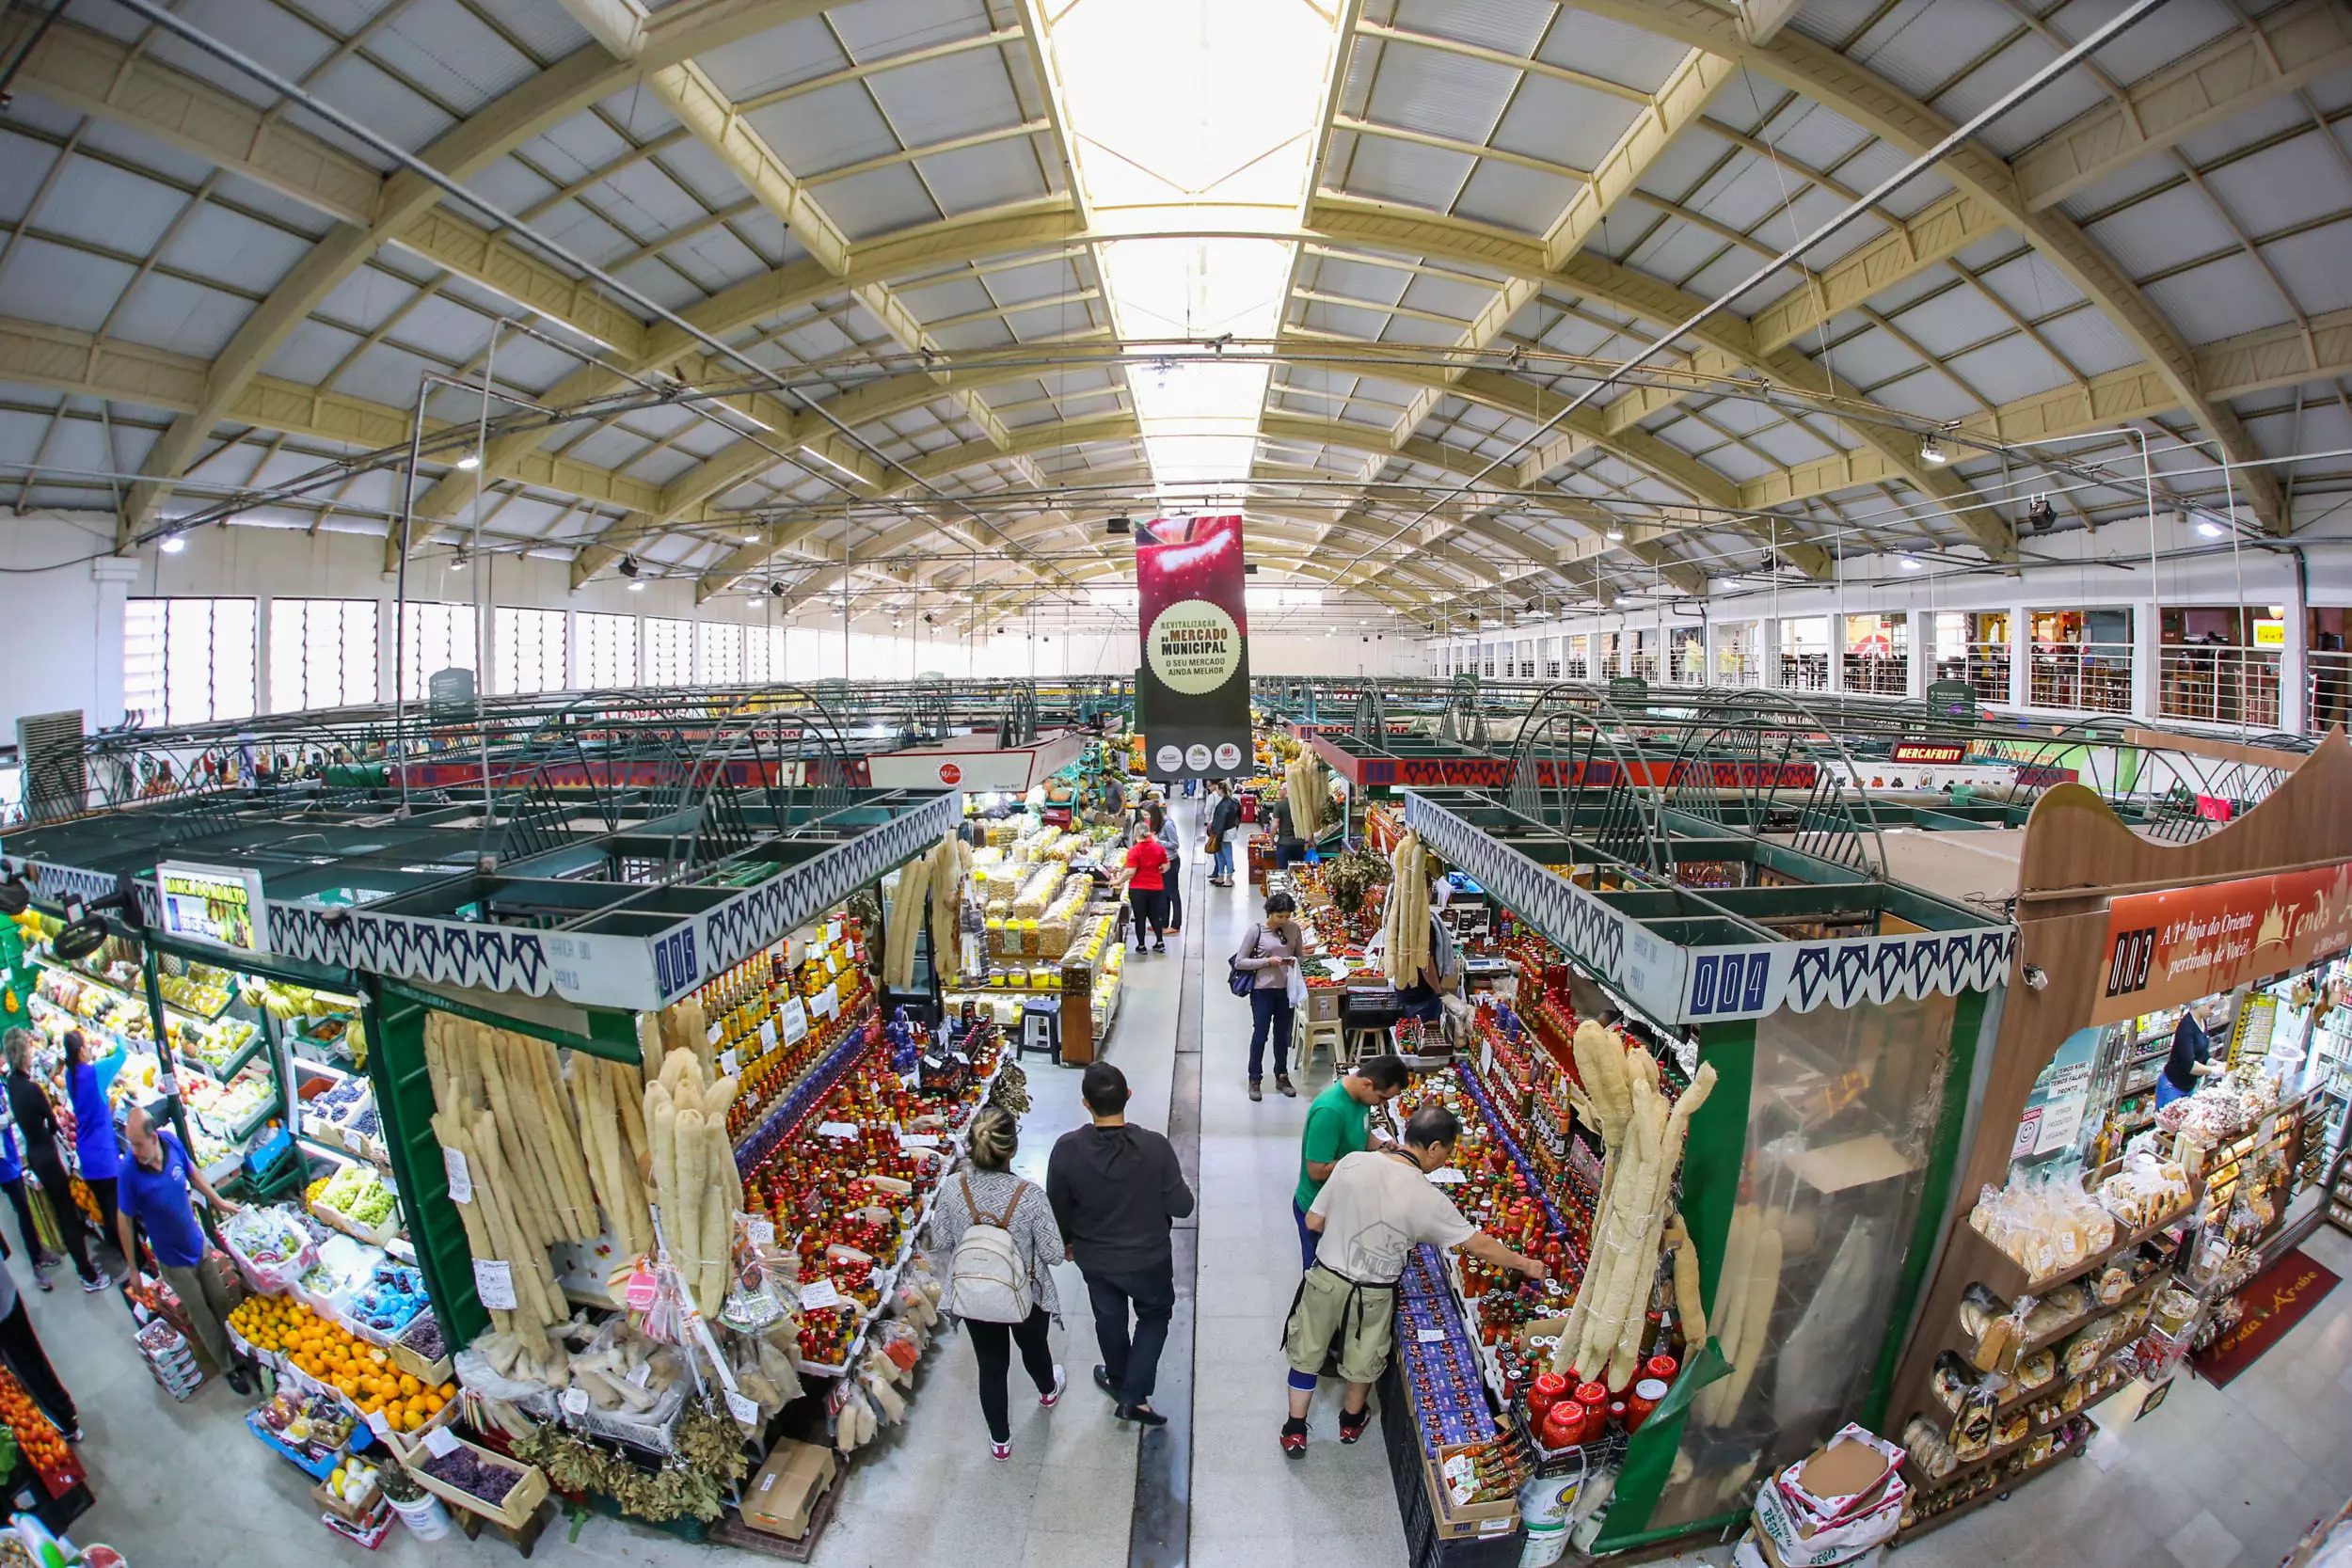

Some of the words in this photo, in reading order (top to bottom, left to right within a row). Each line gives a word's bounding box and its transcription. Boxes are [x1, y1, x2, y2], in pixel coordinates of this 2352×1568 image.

[1161, 619, 1216, 629] REVITALIZAÇÃO
[1169, 627, 1228, 641] MERCADO
[1162, 641, 1227, 656] MUNICIPAL
[1173, 658, 1187, 667] SEU
[1188, 657, 1225, 666] MERCADO
[1168, 668, 1192, 676] AINDA
[1194, 667, 1224, 675] MELHOR
[1897, 748, 1961, 760] MERCAFRUTY
[195, 879, 210, 899] DO
[210, 882, 248, 905] ADALTO
[2282, 889, 2329, 939] Tenda
[2160, 925, 2171, 946] A
[2185, 918, 2205, 946] loja
[2207, 913, 2219, 936] do
[2221, 911, 2254, 933] Oriente
[659, 934, 694, 990] 005
[2110, 934, 2153, 990] 003
[2167, 947, 2212, 982] pertinho
[2213, 943, 2223, 964] de
[2226, 937, 2249, 958] Você!
[1697, 961, 1762, 1007] 004
[2057, 1065, 2074, 1075] TEMOS
[2074, 1061, 2088, 1071] KIBE
[2050, 1078, 2068, 1087] TEMOS
[2068, 1071, 2090, 1082] FALAFEL
[2057, 1085, 2078, 1095] PRONTO
[2273, 1271, 2318, 1314] Árabe
